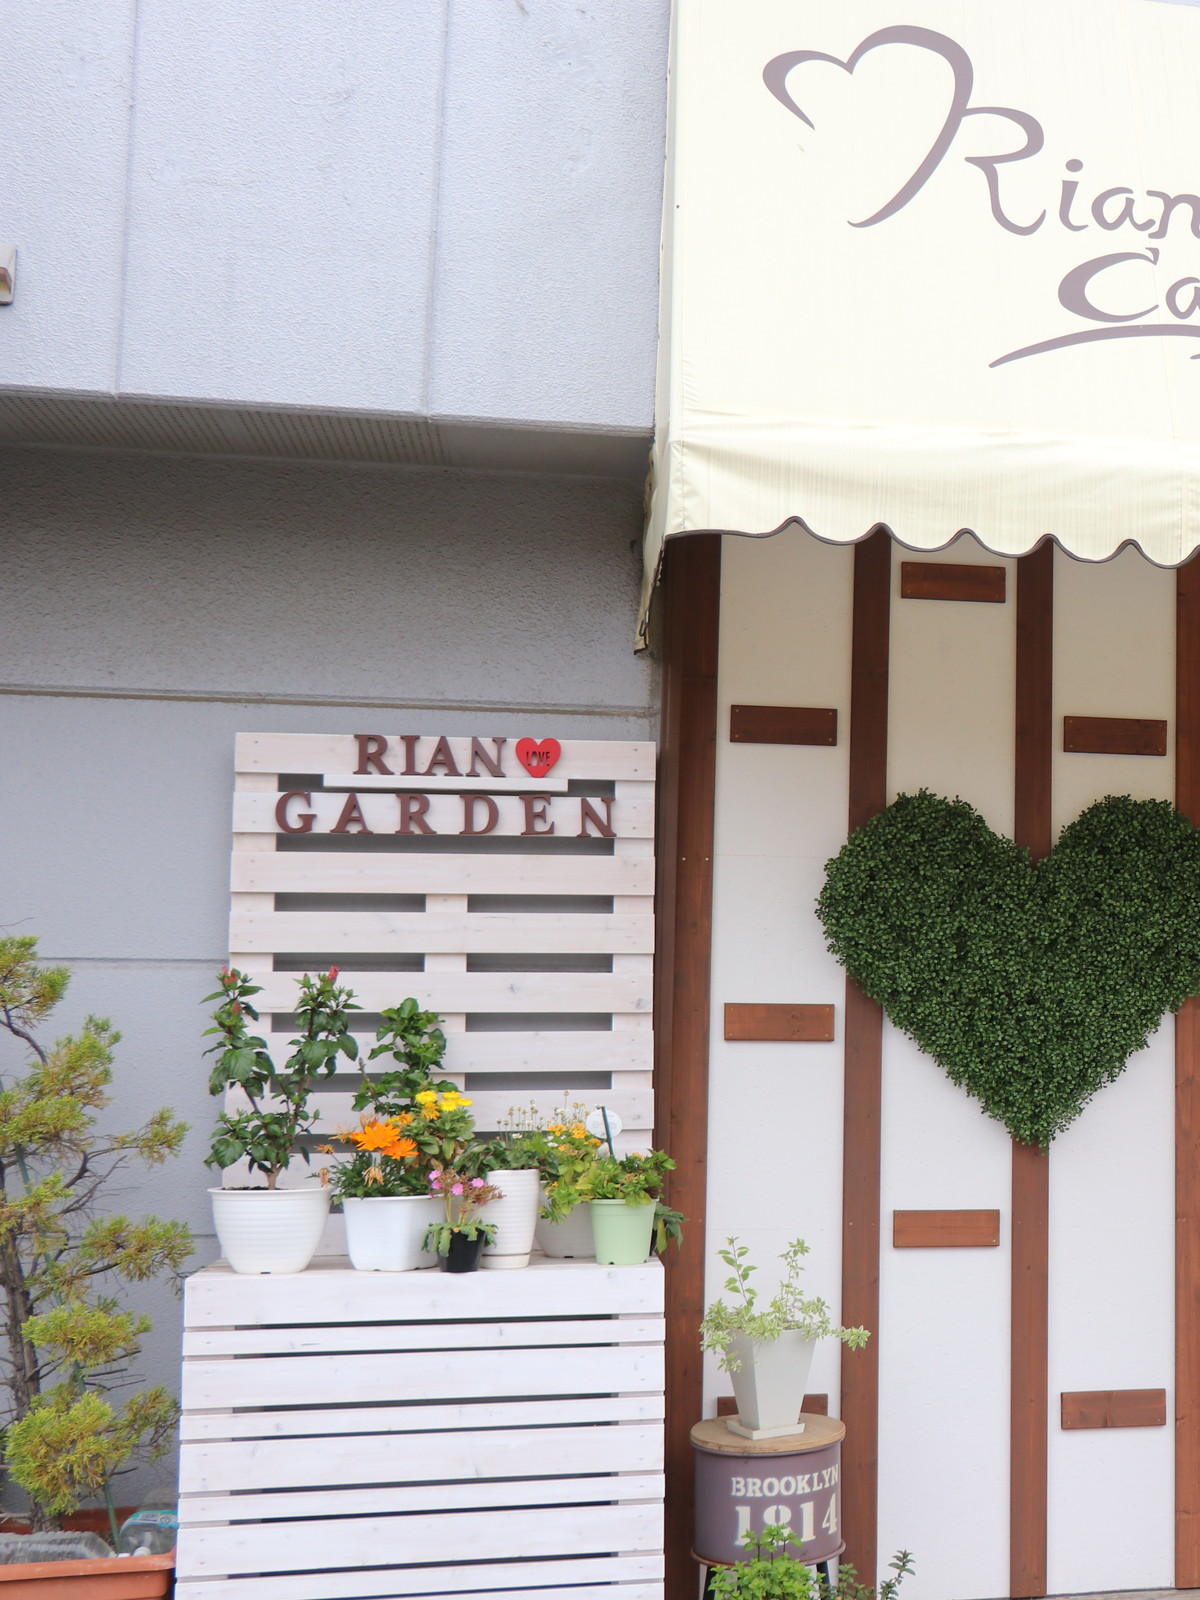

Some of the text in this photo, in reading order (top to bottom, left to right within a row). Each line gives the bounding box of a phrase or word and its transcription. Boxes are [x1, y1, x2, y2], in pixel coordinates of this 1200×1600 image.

[353, 734, 507, 778] RIAN
[526, 751, 550, 767] LOVE
[275, 790, 617, 838] GARDEN
[731, 1464, 839, 1497] BROOKLYN
